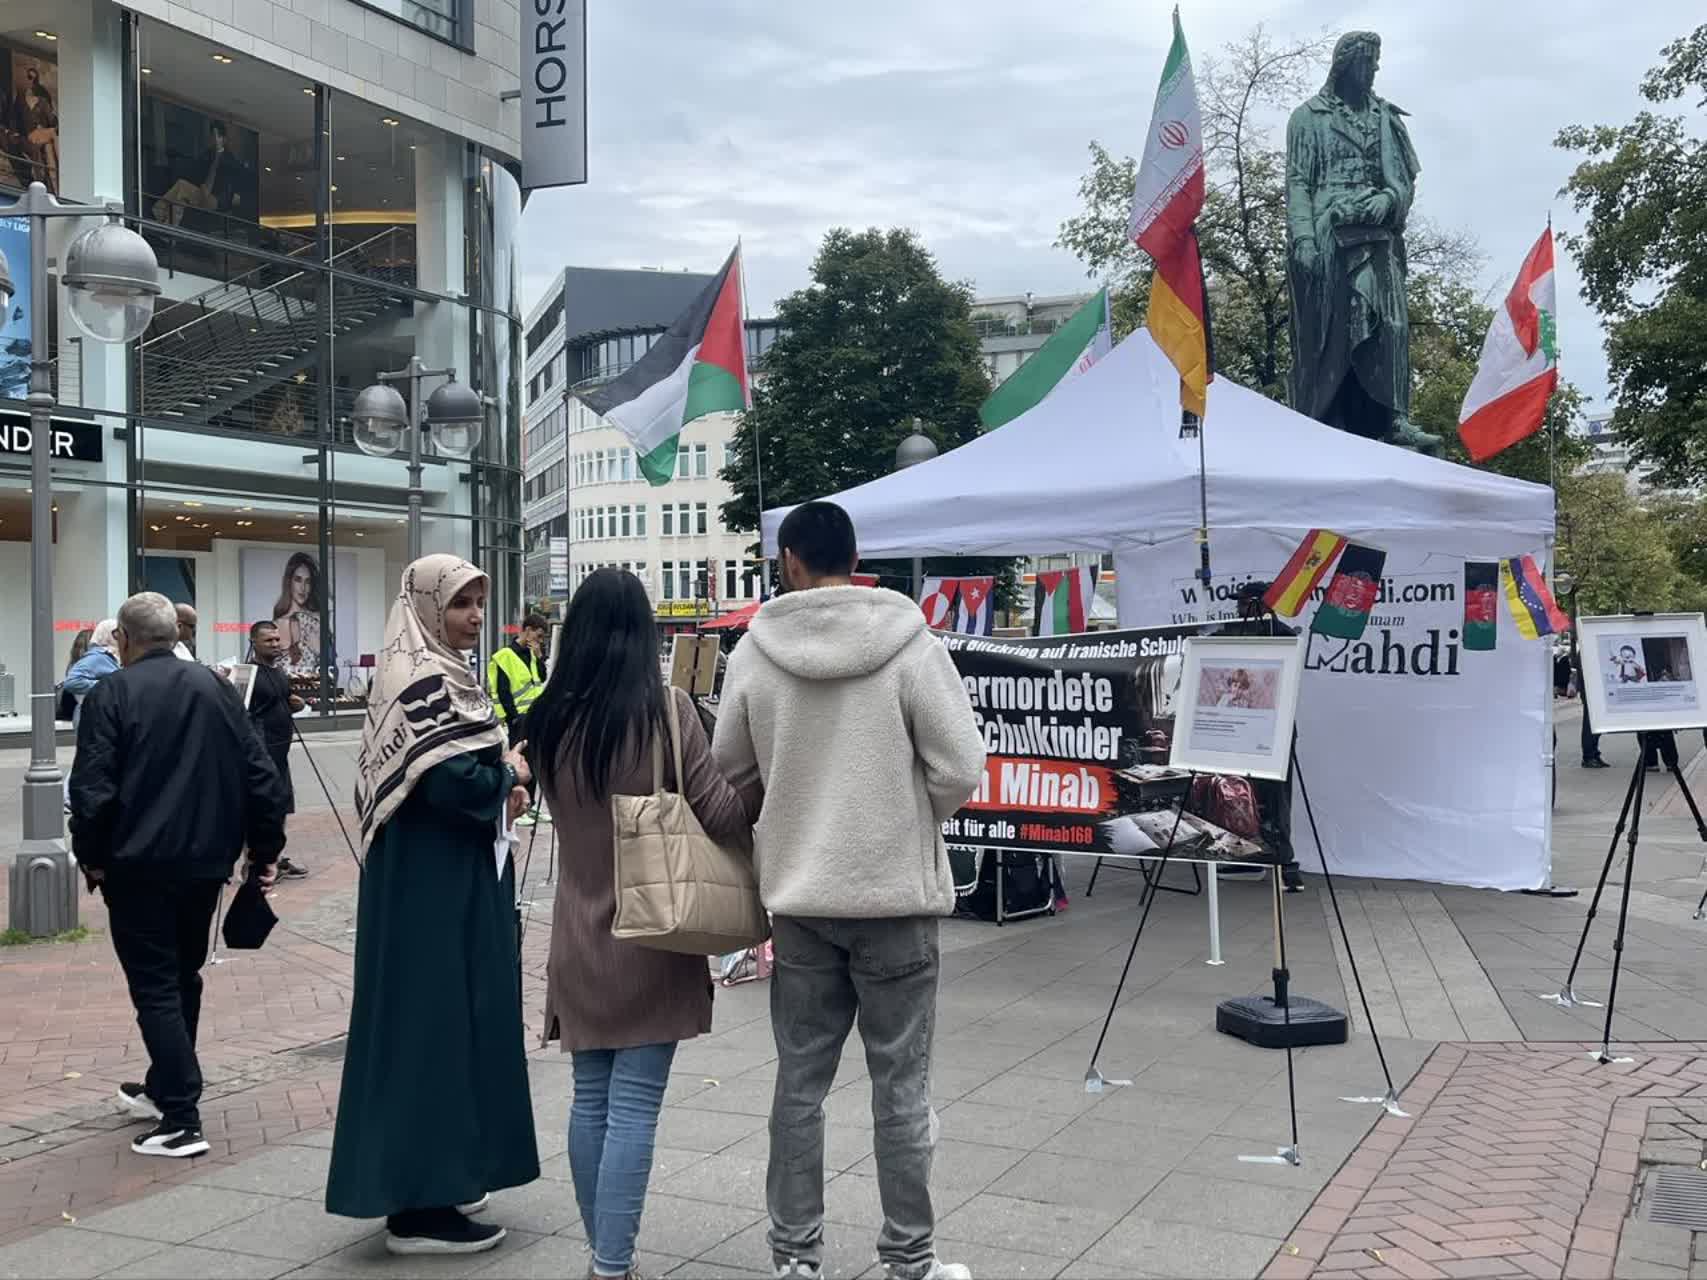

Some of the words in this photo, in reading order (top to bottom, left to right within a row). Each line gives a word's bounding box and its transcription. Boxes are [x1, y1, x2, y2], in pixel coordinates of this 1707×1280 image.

[0, 425, 73, 456] NDR
[1218, 610, 1239, 621] Im
[1368, 615, 1405, 626] mam
[942, 635, 965, 651] her
[1040, 645, 1065, 659] auf
[1068, 639, 1136, 658] iranische
[1304, 628, 1460, 676] Mahdi
[962, 670, 1113, 712] ermordete
[968, 769, 990, 802] n
[1000, 762, 1100, 809] Minab
[942, 818, 960, 836] eit
[963, 818, 986, 837] für
[988, 821, 1016, 839] alle
[1020, 823, 1093, 844] #Minab168
